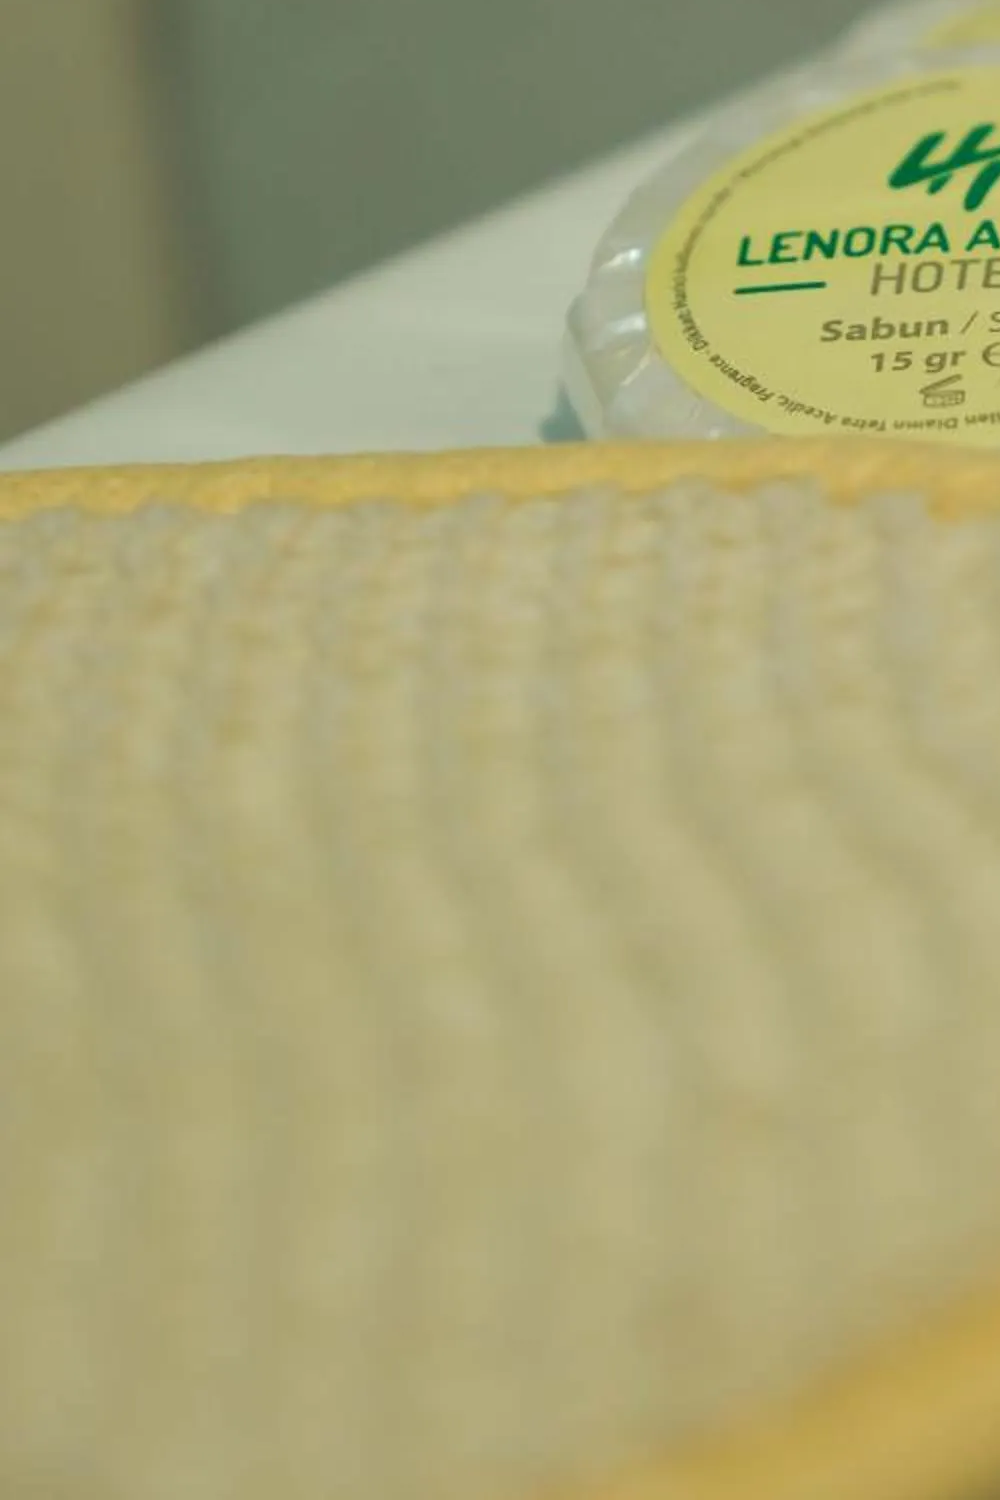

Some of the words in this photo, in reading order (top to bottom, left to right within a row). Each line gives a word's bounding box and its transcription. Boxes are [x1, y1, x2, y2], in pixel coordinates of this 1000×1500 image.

[736, 222, 950, 267] LENORA
[820, 316, 949, 343] Sabun
[870, 350, 913, 373] 15
[924, 350, 967, 374] gr
